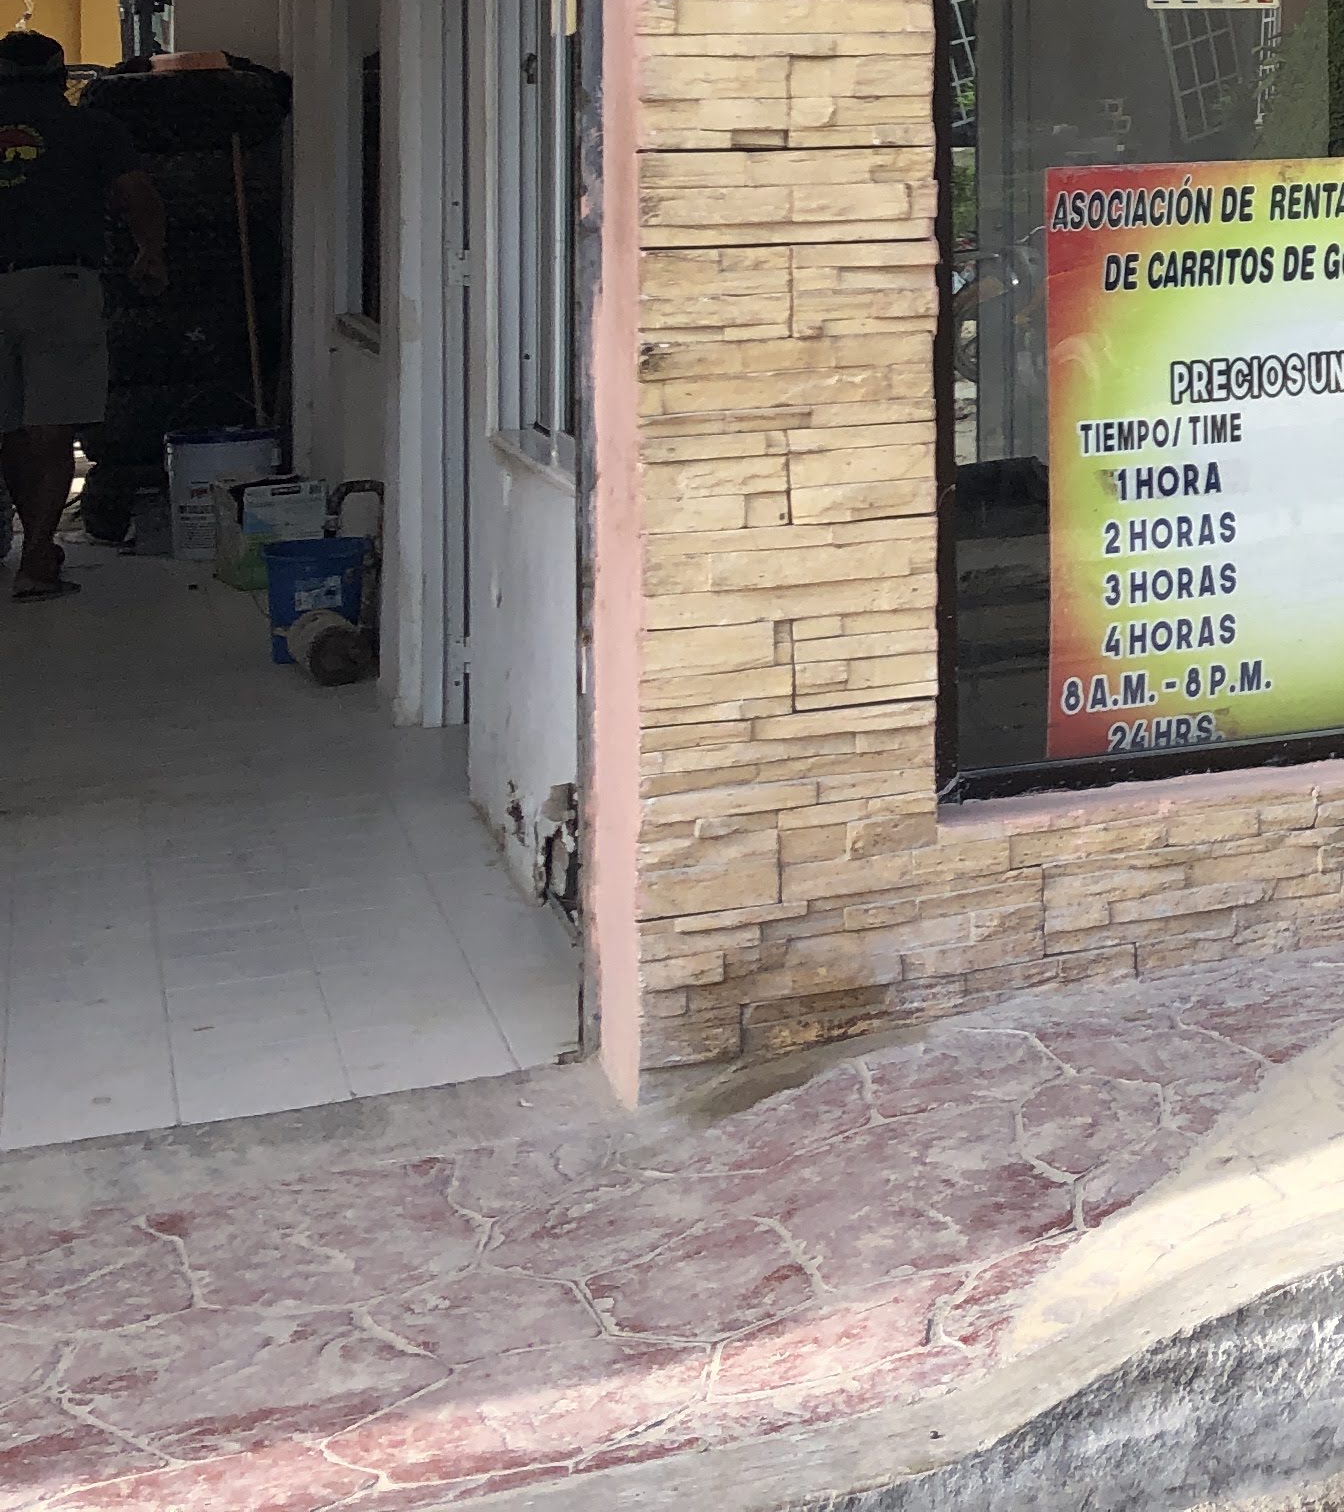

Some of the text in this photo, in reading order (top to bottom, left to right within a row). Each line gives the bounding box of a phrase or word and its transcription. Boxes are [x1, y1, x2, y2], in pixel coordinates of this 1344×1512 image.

[1051, 176, 1210, 231] ASOCIACIÓN
[1221, 184, 1254, 224] DE
[1104, 252, 1138, 292] DE
[1147, 246, 1276, 289] CARRITOS
[1283, 243, 1317, 283] DE
[1170, 353, 1304, 404] PRECIOS
[1189, 413, 1243, 445] TIME
[1133, 461, 1222, 501] HORA
[1104, 511, 1237, 555] 2 HORAS
[1104, 562, 1237, 607] 3 HORAS
[1104, 613, 1237, 657] 4 HORAS
[1063, 680, 1081, 713] 8
[1090, 672, 1156, 710] A.M.
[1186, 667, 1201, 699] 8
[1209, 659, 1272, 696] P.M.
